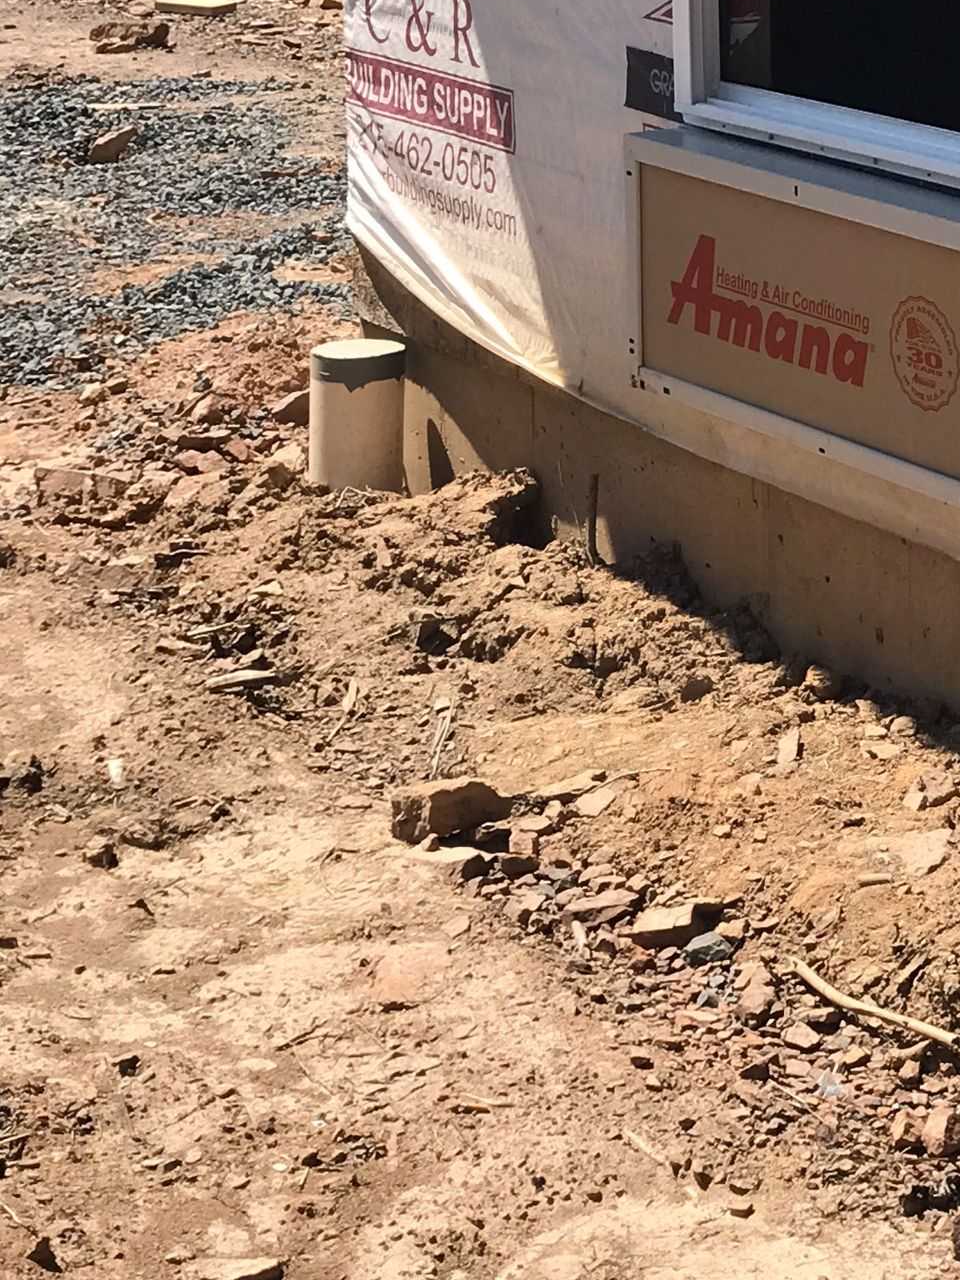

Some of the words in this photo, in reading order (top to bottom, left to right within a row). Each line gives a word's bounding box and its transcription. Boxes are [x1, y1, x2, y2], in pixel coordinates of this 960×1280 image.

[433, 82, 509, 139] SUPPLY
[667, 234, 869, 388] Amana
[716, 267, 758, 299] Heating
[761, 281, 769, 298] &
[773, 285, 790, 304] Air
[793, 290, 870, 335] Conditioning
[906, 346, 943, 369] 30
